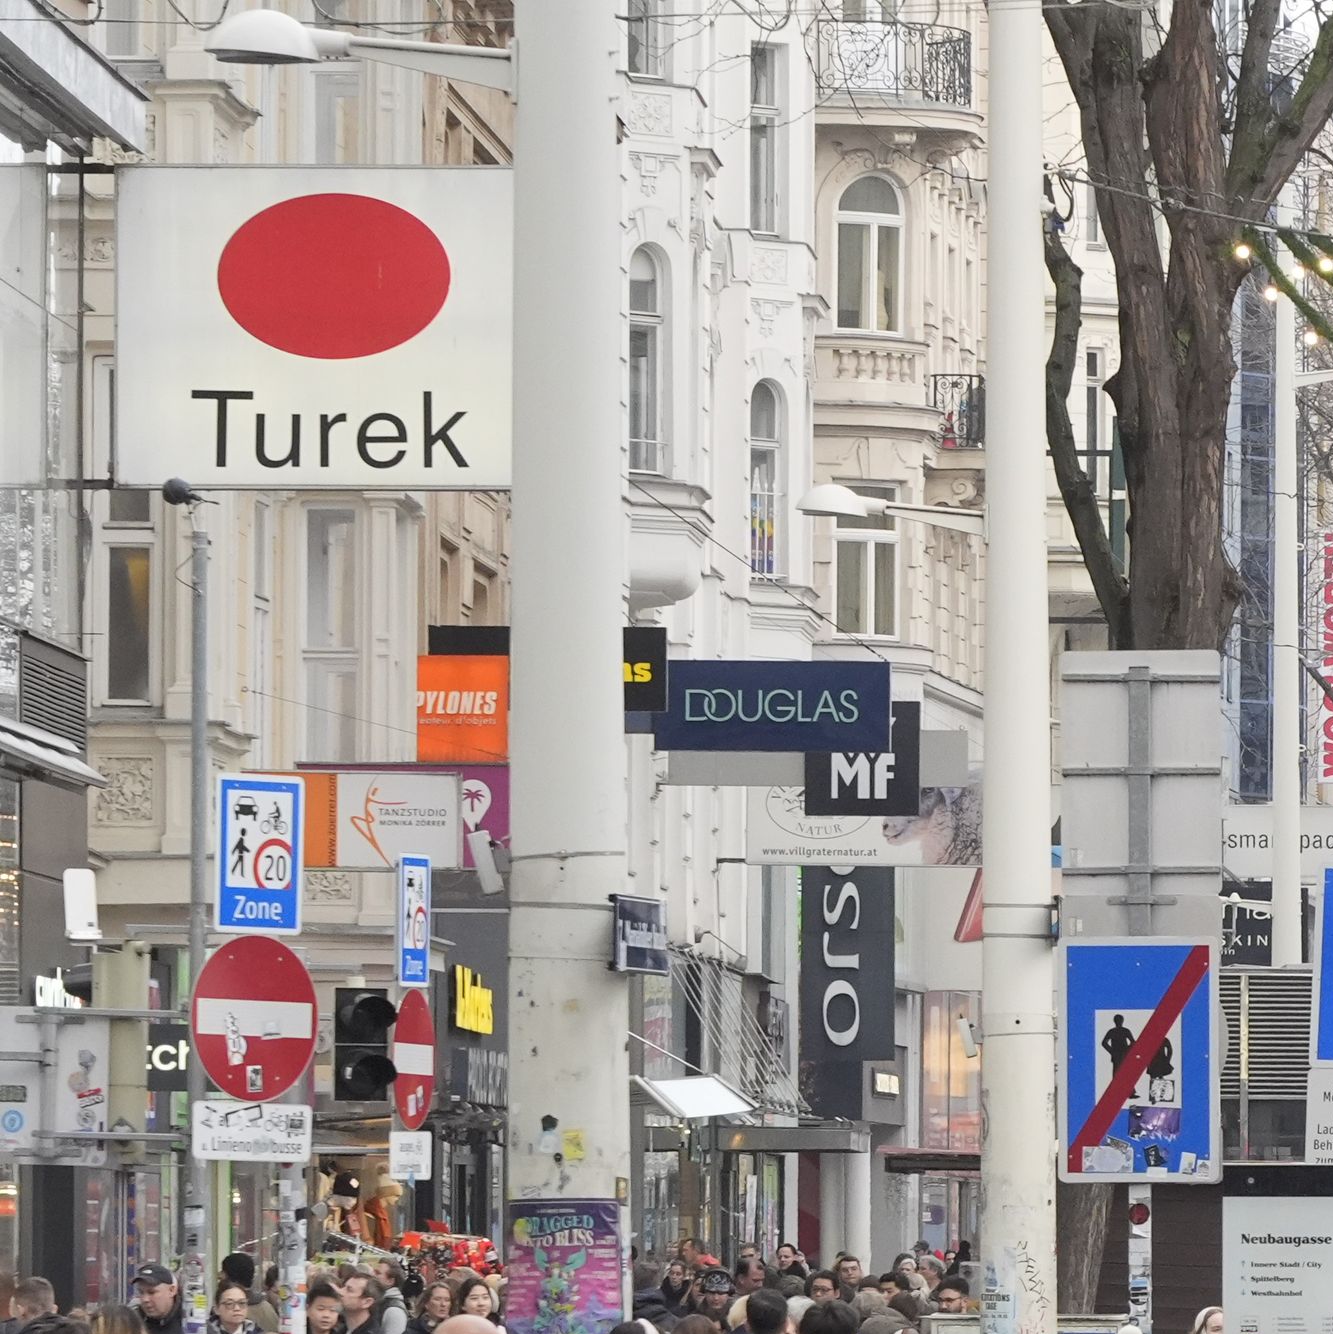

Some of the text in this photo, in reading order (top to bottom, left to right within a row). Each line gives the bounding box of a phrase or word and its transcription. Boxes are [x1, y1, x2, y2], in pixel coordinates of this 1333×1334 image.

[191, 389, 470, 469] Turek
[415, 690, 497, 715] PYLONES
[684, 688, 860, 723] DOUGLAS
[379, 807, 448, 817] TANZSTUDIO
[796, 821, 842, 836] NATUR
[762, 845, 878, 857] www.villgraternatur.at
[264, 854, 286, 882] 20
[233, 895, 283, 921] Zone
[555, 1229, 595, 1247] BLISS
[1240, 1233, 1333, 1248] Neubaugasse
[1250, 1260, 1278, 1269] Innere
[1250, 1275, 1295, 1284] Spittelberg
[1250, 1289, 1303, 1298] Westbahnhof
